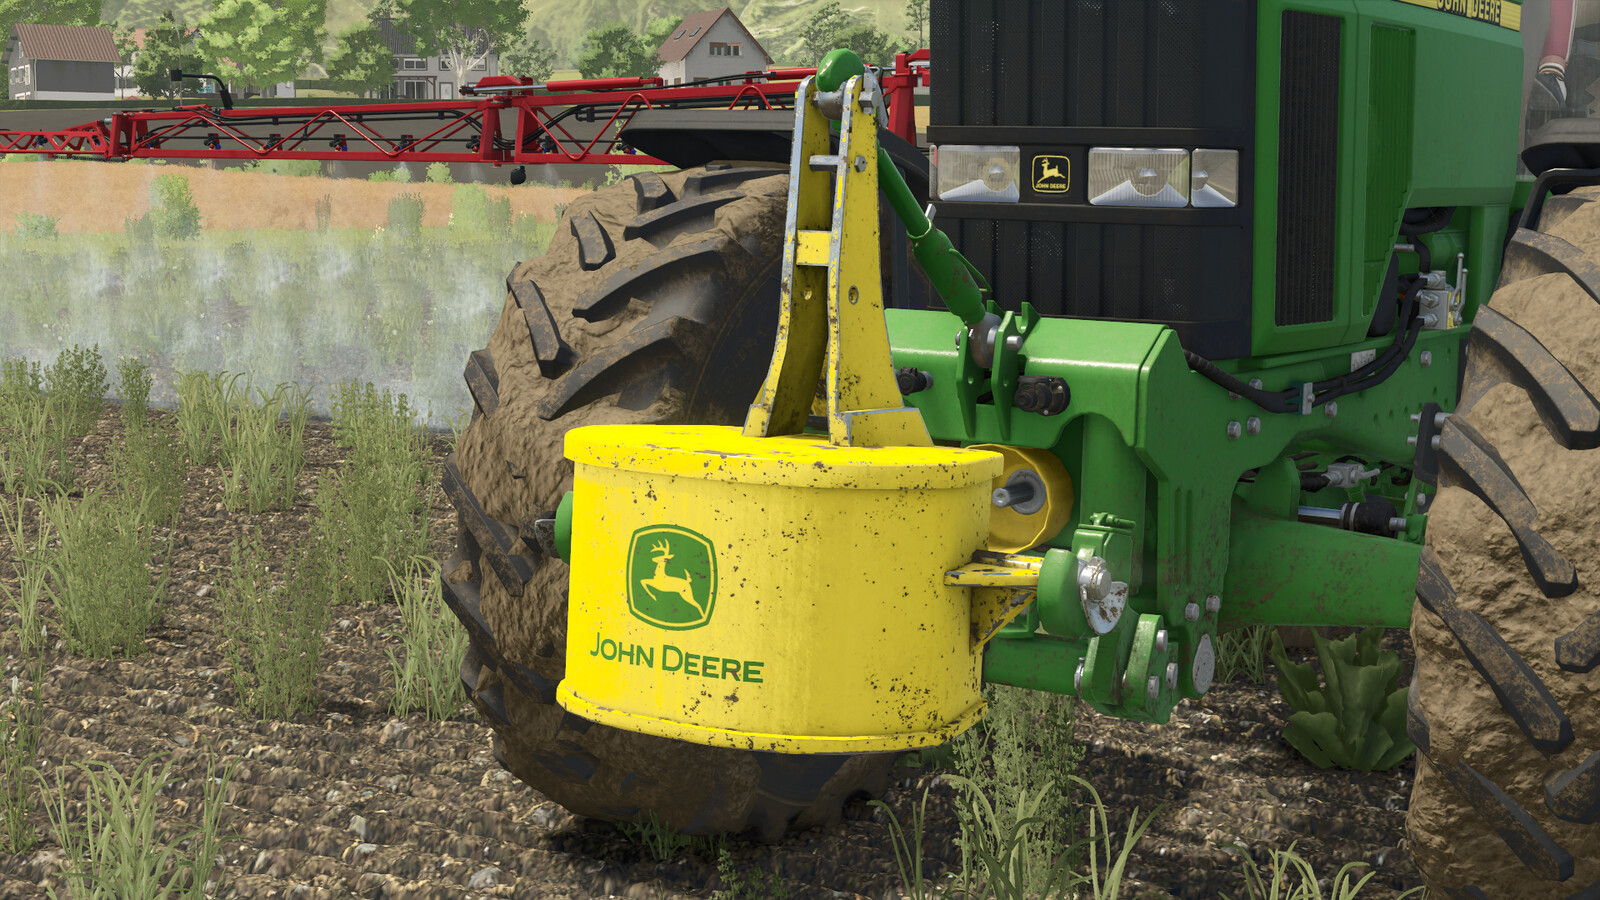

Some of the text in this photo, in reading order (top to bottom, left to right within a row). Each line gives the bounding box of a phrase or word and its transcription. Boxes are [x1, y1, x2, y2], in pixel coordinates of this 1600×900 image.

[1472, 0, 1500, 23] DEERE
[590, 632, 764, 683] JOHN DEERE
